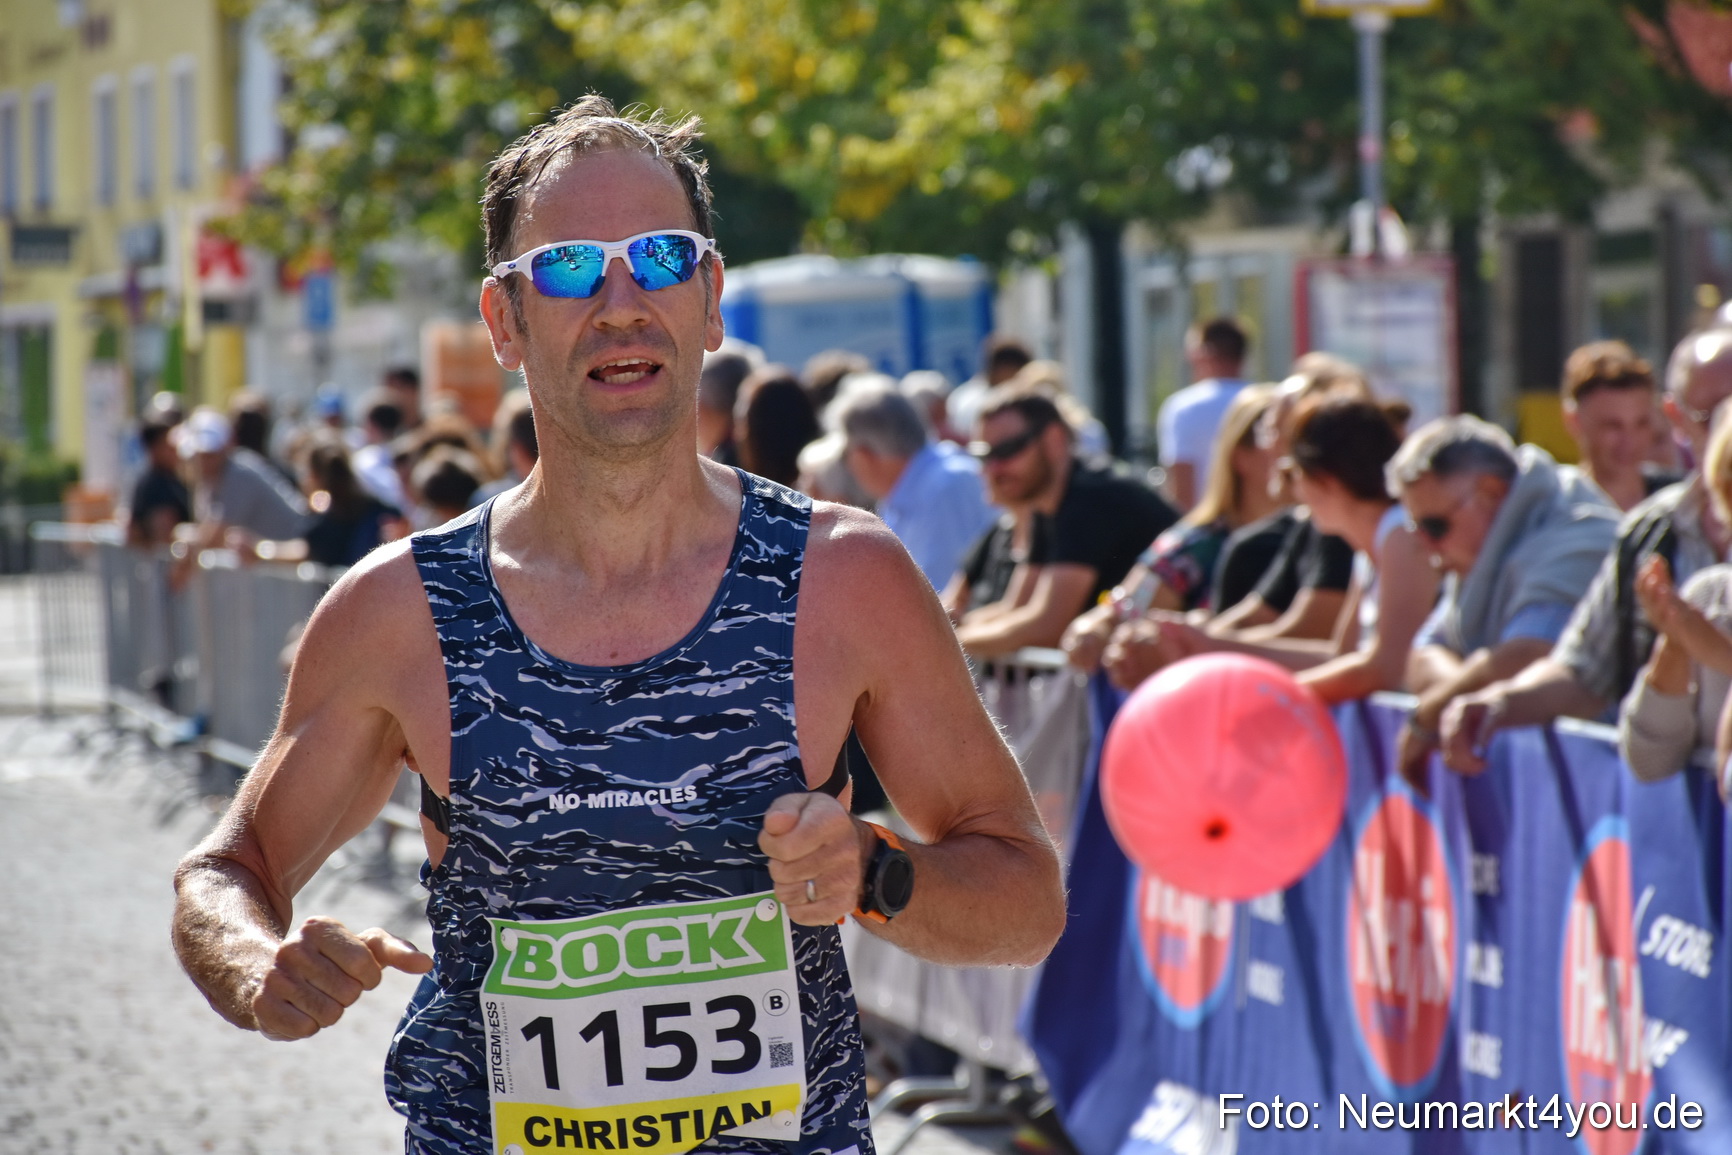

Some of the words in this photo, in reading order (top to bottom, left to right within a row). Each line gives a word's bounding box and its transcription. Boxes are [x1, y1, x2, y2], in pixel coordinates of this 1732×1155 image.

[550, 793, 580, 809] NO
[588, 785, 698, 808] MIRACLES
[501, 912, 766, 989] BOCK
[500, 1001, 510, 1045] ZEITMESSUNG
[769, 995, 783, 1010] B
[520, 994, 762, 1091] 1153
[505, 1049, 515, 1094] TRANSPONDER
